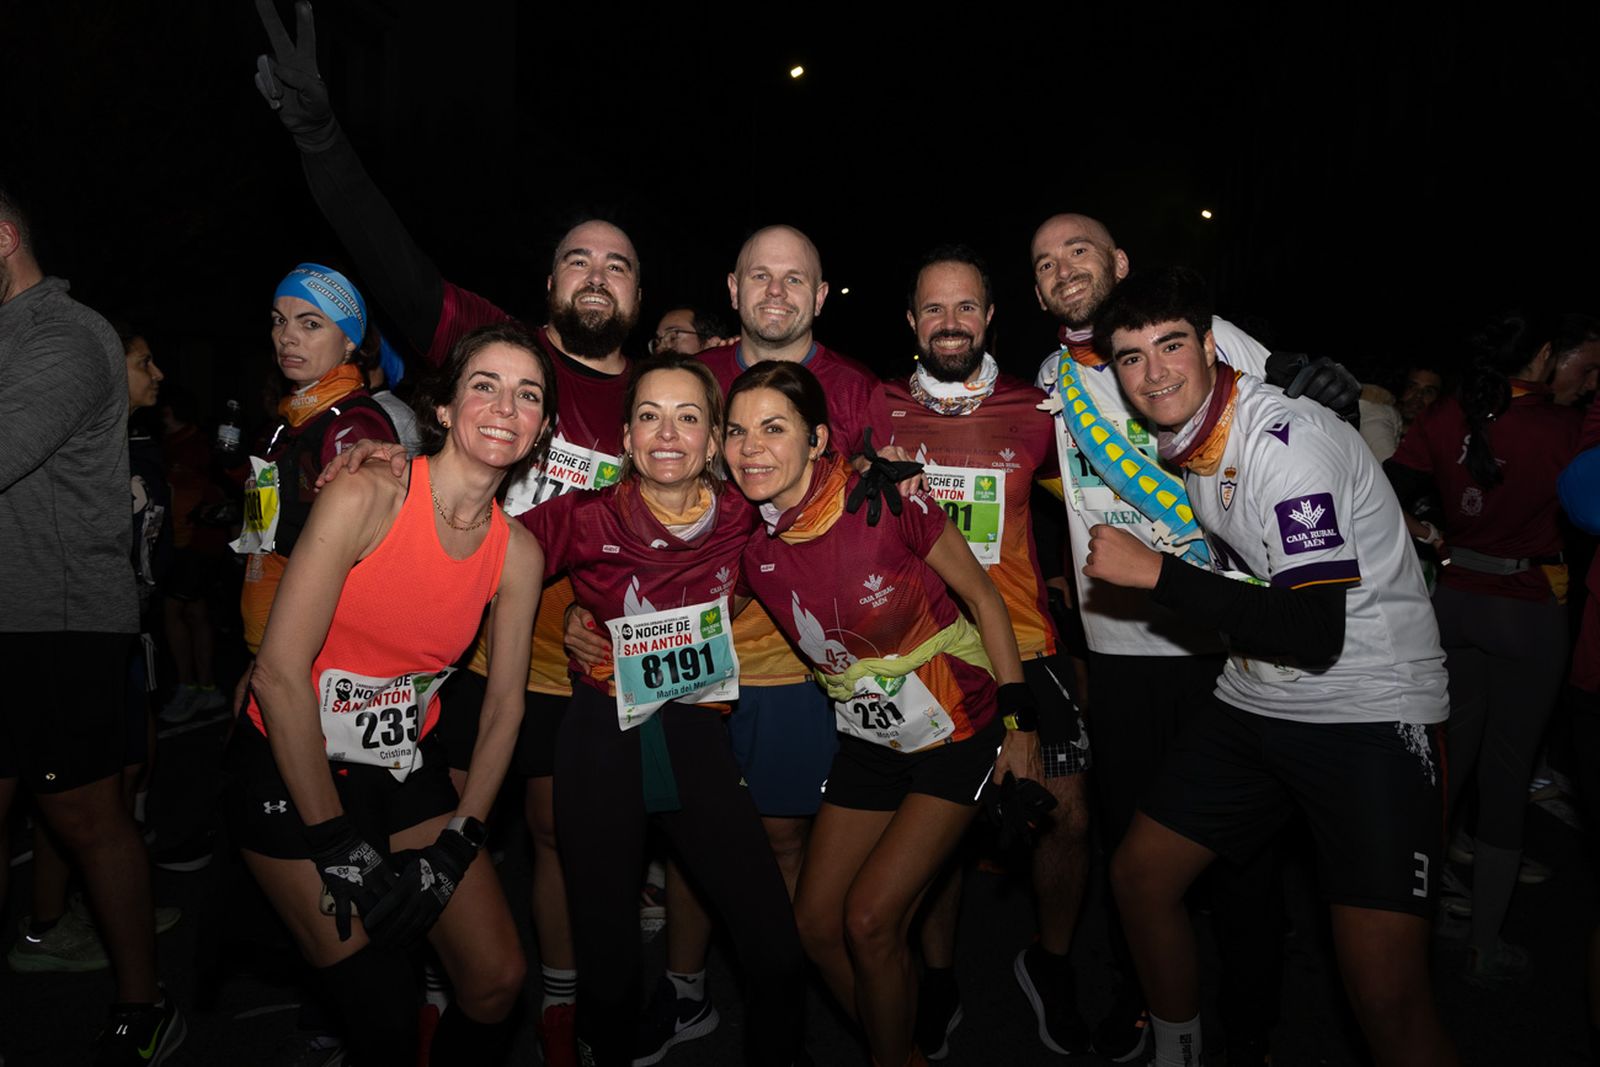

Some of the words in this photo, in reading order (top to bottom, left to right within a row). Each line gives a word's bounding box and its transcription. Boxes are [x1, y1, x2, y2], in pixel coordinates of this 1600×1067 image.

[549, 465, 588, 485] ANTÓN
[927, 476, 952, 487] OCHE
[953, 479, 965, 488] DE
[930, 486, 965, 500] ANTÓN
[1310, 529, 1337, 539] RURAL
[636, 622, 674, 639] NOCHE
[676, 620, 690, 632] DE
[624, 641, 648, 656] SAN
[651, 632, 692, 651] ANTÓN
[642, 642, 715, 689] 8191
[337, 682, 352, 691] 43
[395, 674, 411, 687] DE
[853, 701, 906, 729] 231
[355, 704, 418, 750] 233
[380, 748, 412, 760] Cristina
[1412, 850, 1430, 898] 3
